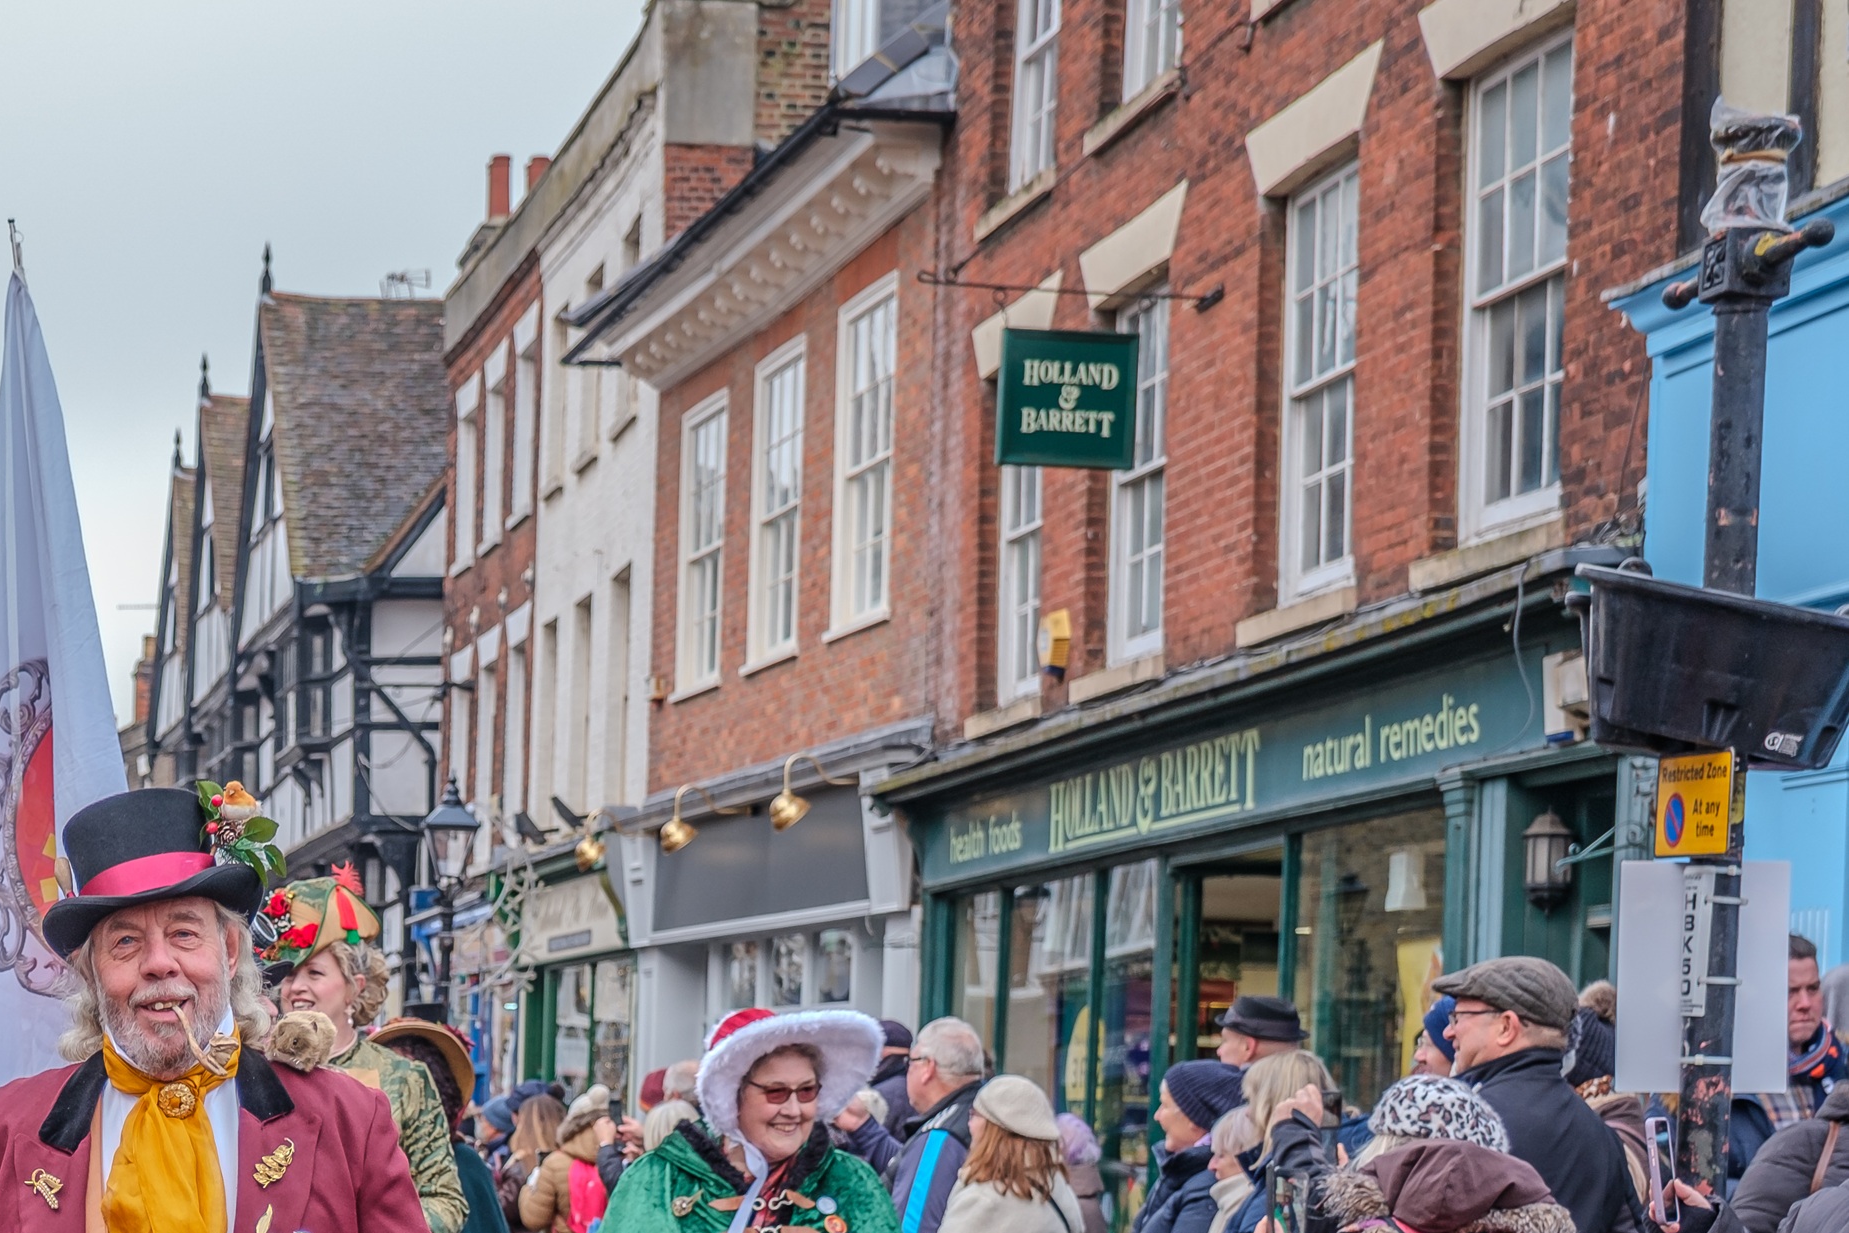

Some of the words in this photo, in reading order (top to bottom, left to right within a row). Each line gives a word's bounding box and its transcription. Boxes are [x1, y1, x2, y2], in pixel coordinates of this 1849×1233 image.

[1022, 359, 1120, 390] HOLLAND
[1058, 384, 1081, 410] &
[1020, 406, 1116, 438] BARRETT
[1302, 713, 1371, 781] natural
[1379, 692, 1480, 764] remedies
[1662, 764, 1704, 782] Restricted
[1706, 762, 1727, 779] Zone
[1049, 762, 1136, 853] HOLLAND
[1136, 756, 1158, 835] &
[1159, 728, 1260, 818] BARRETT
[1692, 799, 1703, 815] At
[1705, 800, 1720, 816] any
[949, 819, 985, 864] health
[988, 810, 1022, 856] foods
[1696, 821, 1714, 837] time
